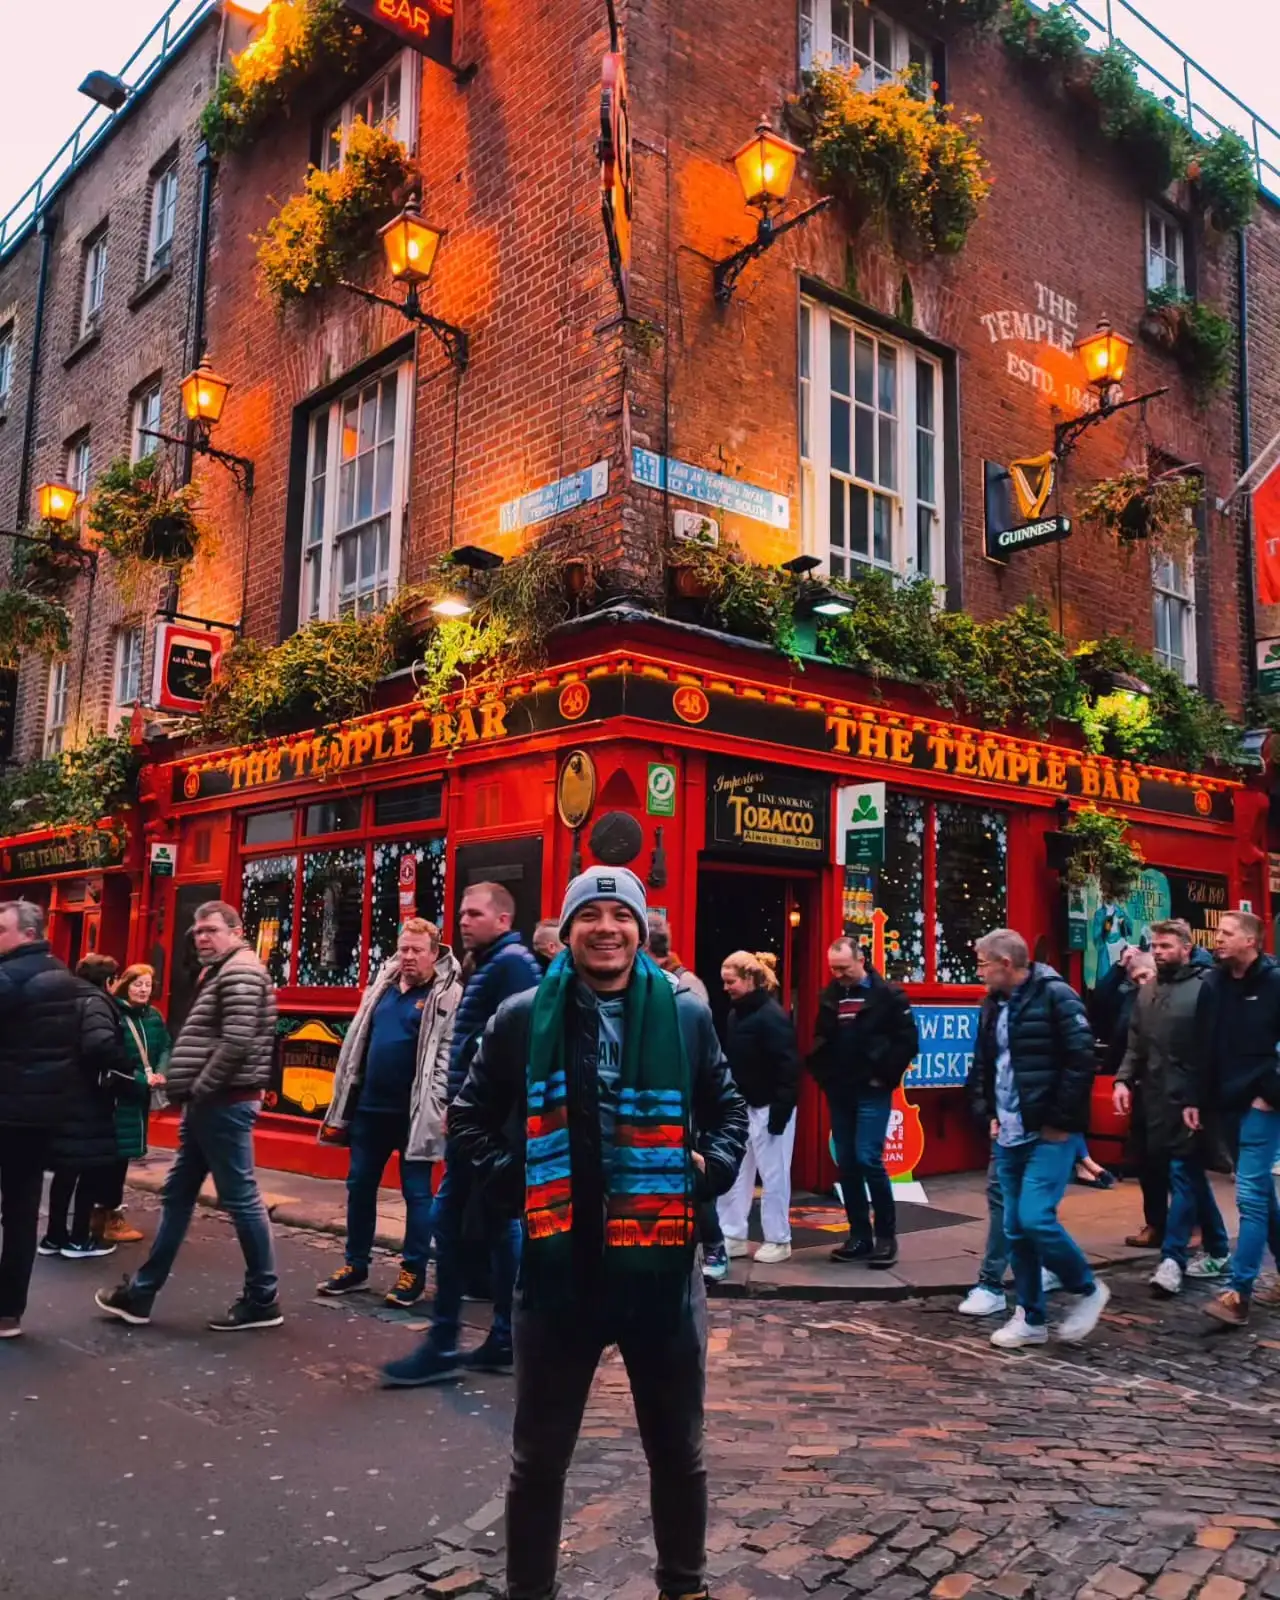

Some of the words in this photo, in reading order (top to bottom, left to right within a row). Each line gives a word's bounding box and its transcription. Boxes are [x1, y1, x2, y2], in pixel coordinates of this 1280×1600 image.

[1034, 281, 1078, 329] THE
[980, 311, 1075, 360] TEMPLE
[595, 471, 604, 489] 2
[998, 519, 1058, 546] GUINNESS
[679, 691, 702, 715] 48
[229, 751, 281, 790] THE
[290, 722, 415, 777] TEMPLE
[431, 701, 508, 749] BAR
[826, 716, 914, 764] THE
[927, 734, 1067, 789] TEMPLE
[1081, 763, 1141, 804] BAR
[713, 771, 764, 796] Importers
[757, 793, 777, 805] FINE
[777, 795, 814, 810] SMOKING
[727, 795, 815, 836] TOBACCO
[745, 831, 778, 845] Always
[795, 836, 821, 849] Stock
[38, 845, 77, 867] TEMPLE
